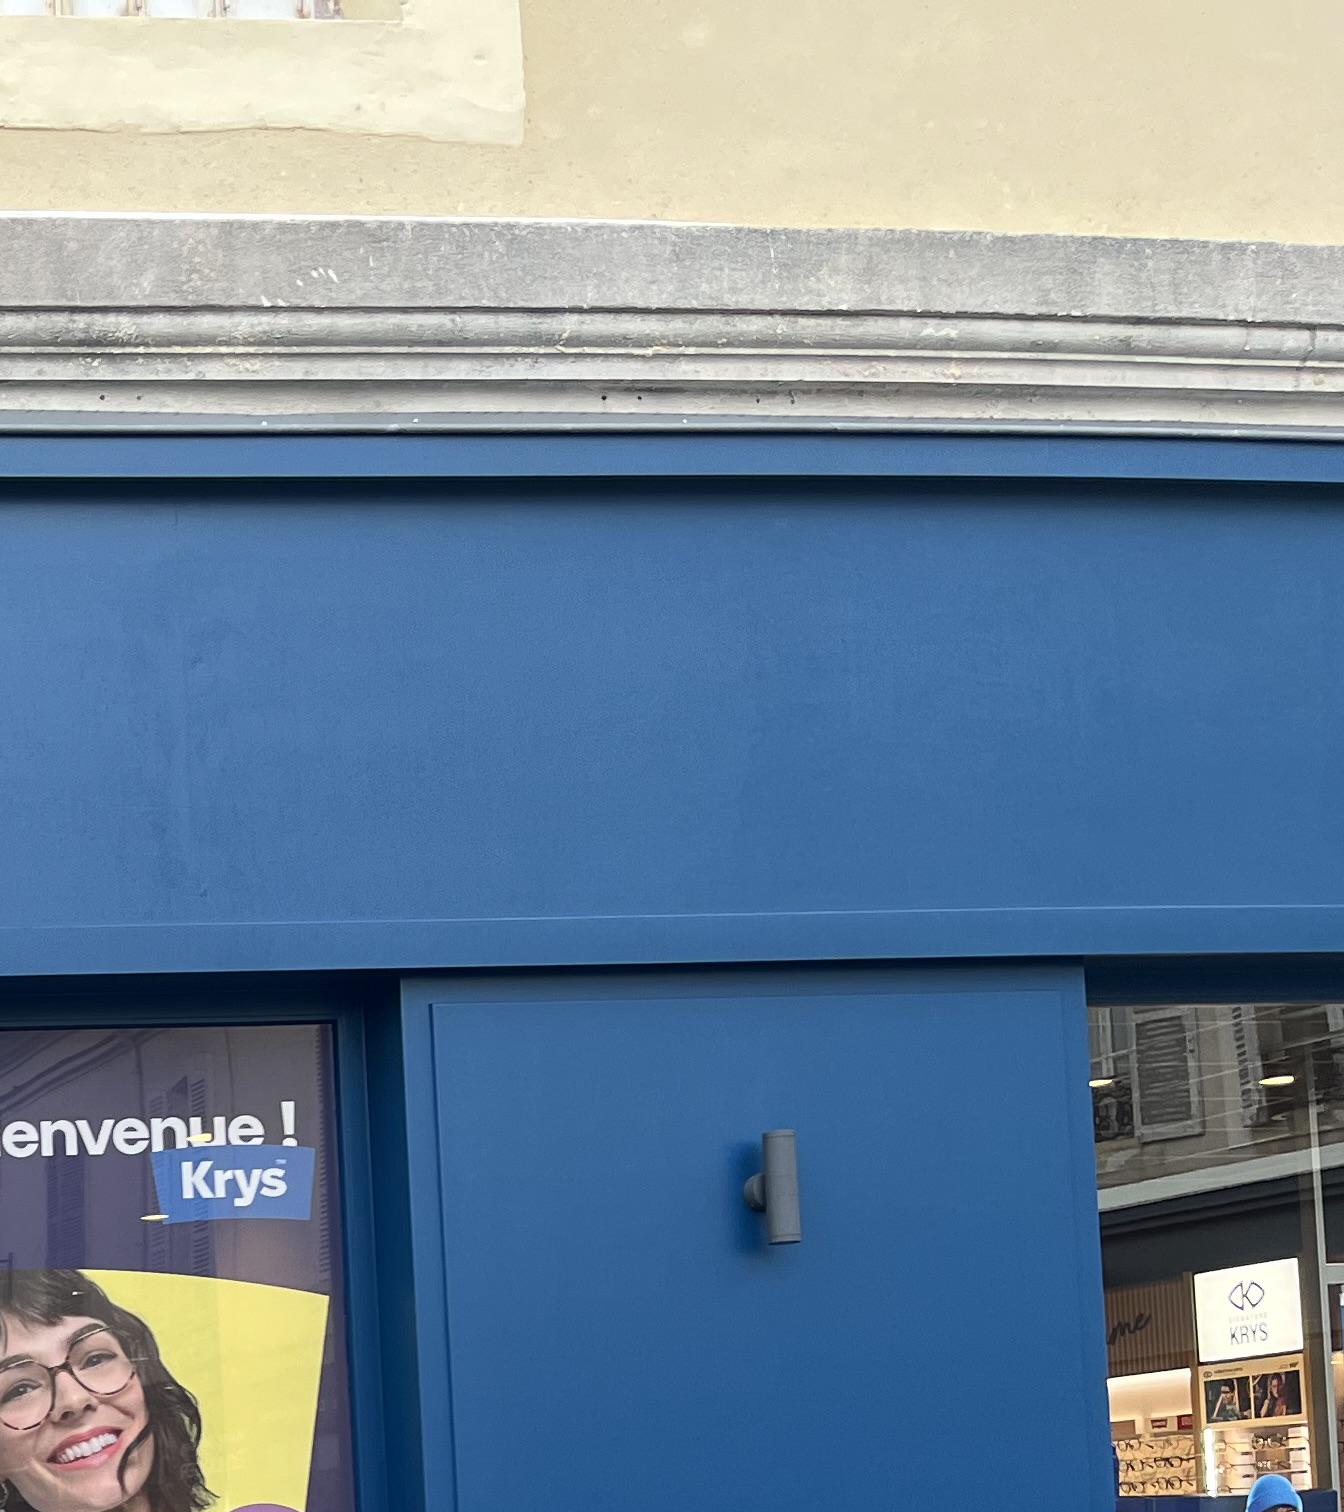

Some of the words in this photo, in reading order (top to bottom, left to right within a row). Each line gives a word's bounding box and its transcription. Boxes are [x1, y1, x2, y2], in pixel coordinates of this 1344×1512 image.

[280, 1101, 298, 1147] !
[181, 1160, 287, 1207] Krys
[1229, 1322, 1268, 1345] KRYS
